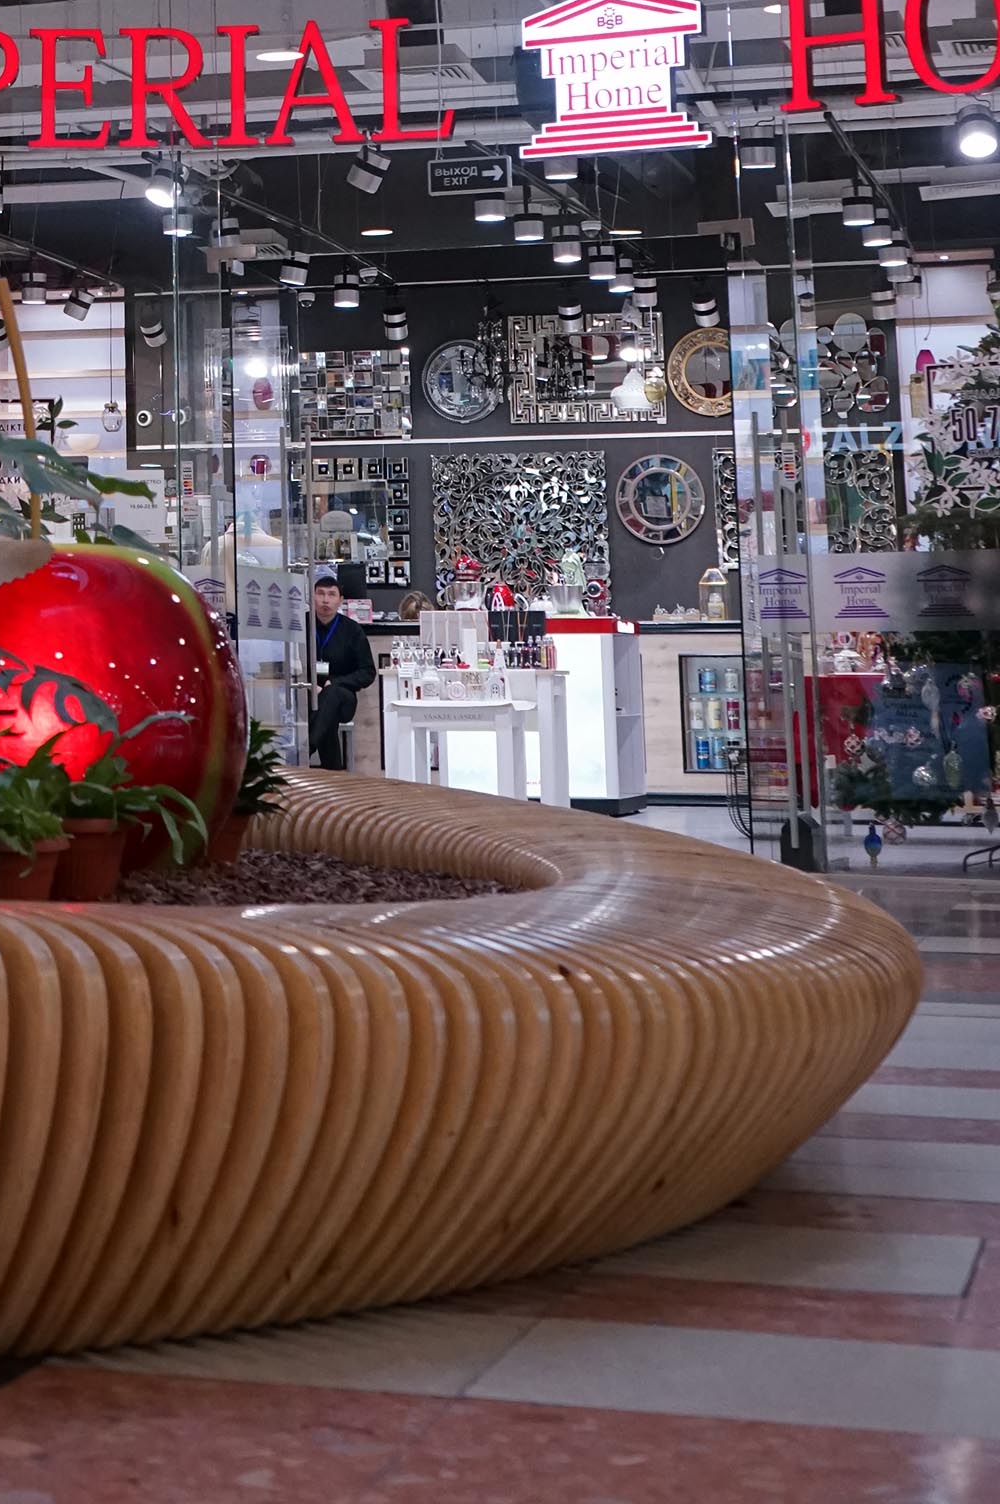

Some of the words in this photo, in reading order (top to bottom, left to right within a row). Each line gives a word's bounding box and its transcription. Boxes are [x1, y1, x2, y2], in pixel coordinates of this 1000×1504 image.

[597, 15, 623, 30] BSB
[545, 36, 680, 81] Imperial
[566, 81, 663, 111] Home
[434, 166, 479, 177] ВЫХОД
[443, 176, 470, 186] EXIT
[840, 584, 881, 596] Imperial
[765, 596, 797, 607] Home
[847, 596, 876, 606] Home
